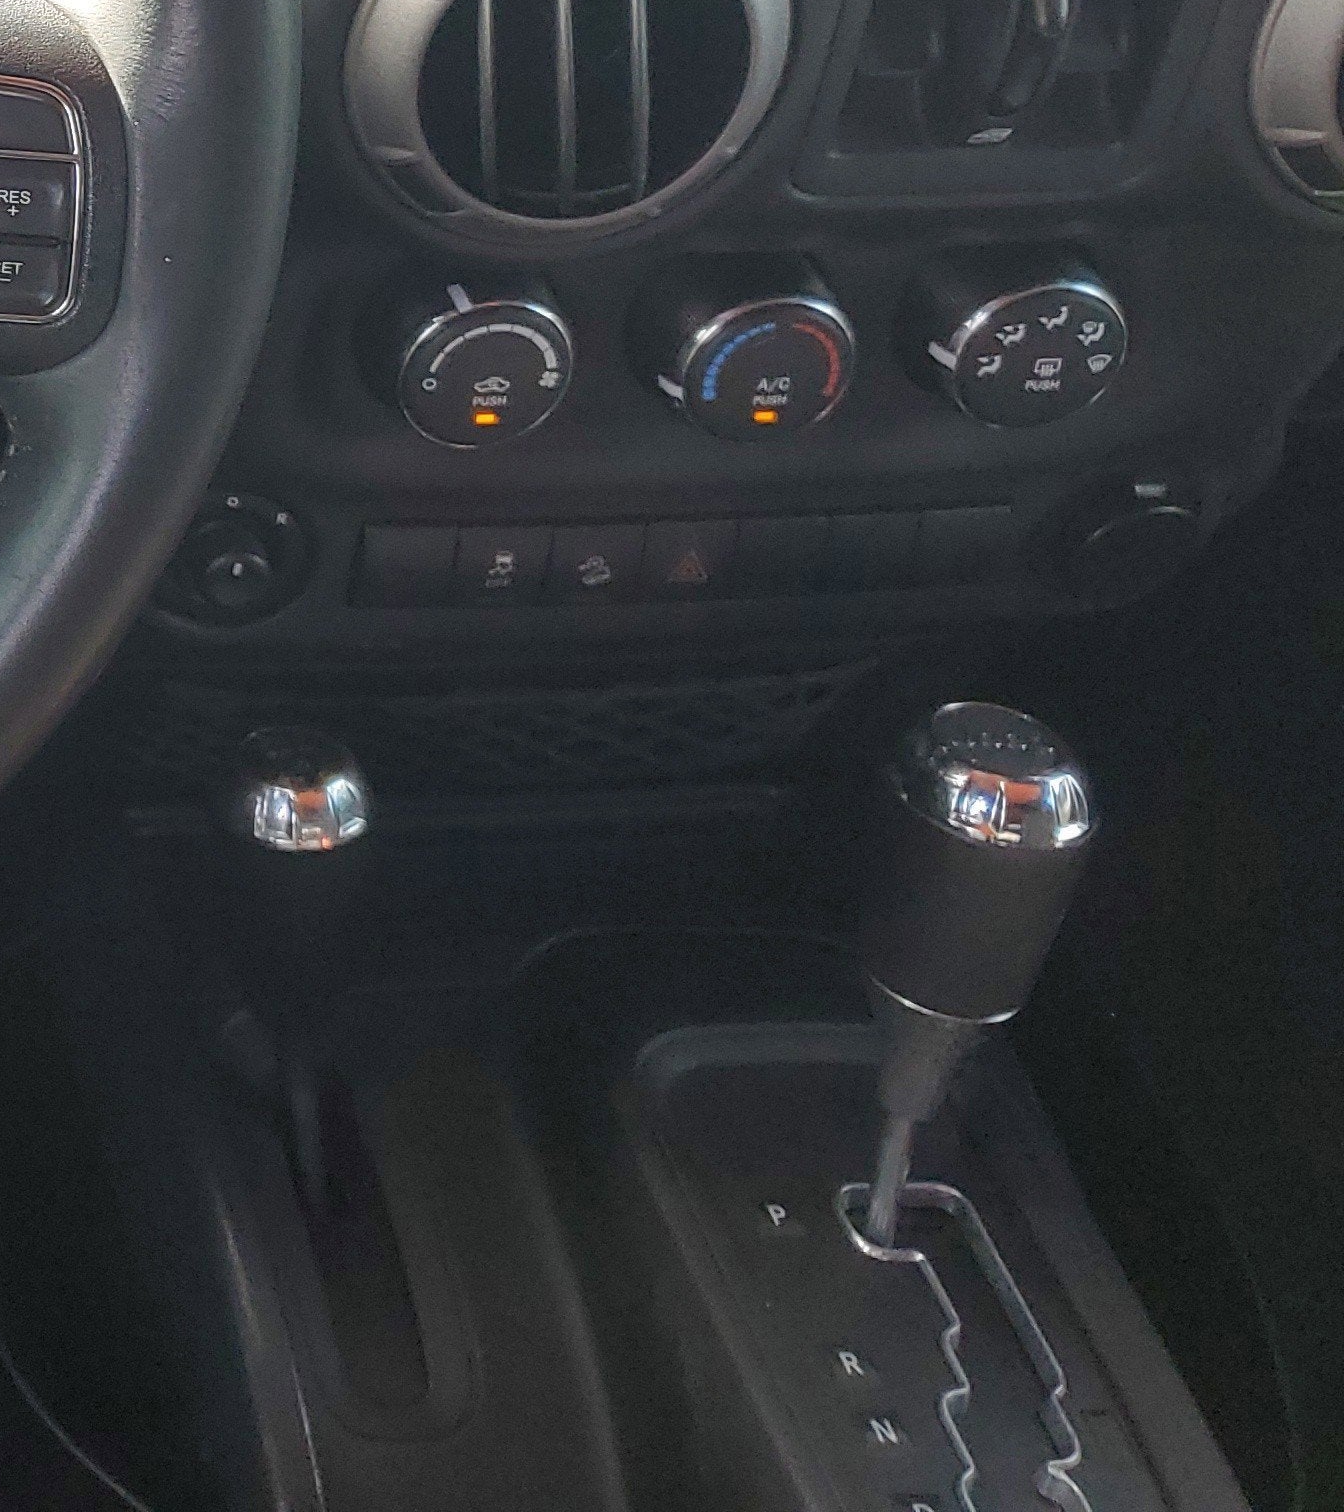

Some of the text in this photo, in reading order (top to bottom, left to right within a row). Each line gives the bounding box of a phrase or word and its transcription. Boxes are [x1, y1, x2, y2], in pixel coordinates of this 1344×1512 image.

[766, 1203, 787, 1228] P
[838, 1350, 864, 1376] R
[870, 1418, 900, 1445] N
